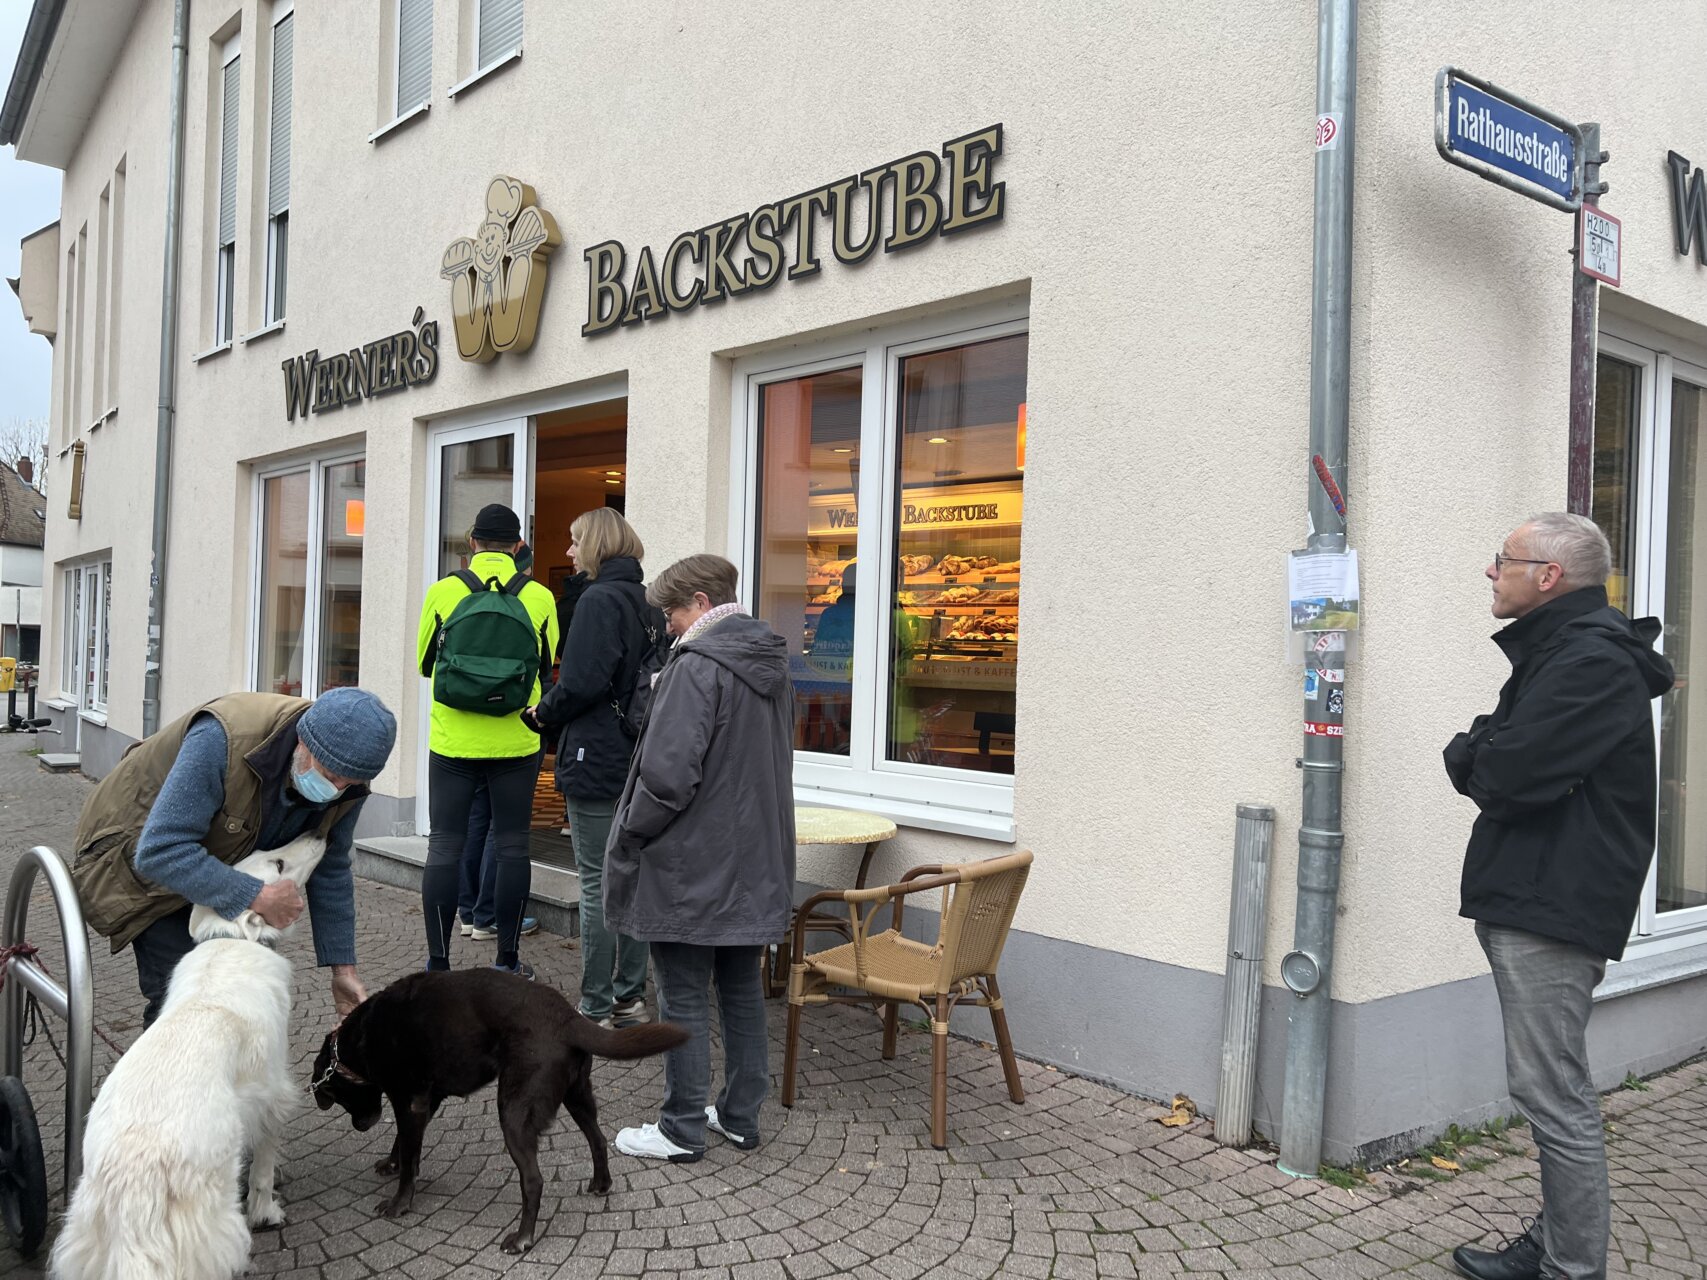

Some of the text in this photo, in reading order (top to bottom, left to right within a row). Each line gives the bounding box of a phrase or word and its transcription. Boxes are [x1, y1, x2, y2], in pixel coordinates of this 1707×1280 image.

[1457, 96, 1567, 182] Rathausstraße
[581, 122, 1005, 337] BACKSTUBE
[903, 503, 998, 525] BACKSTUBE
